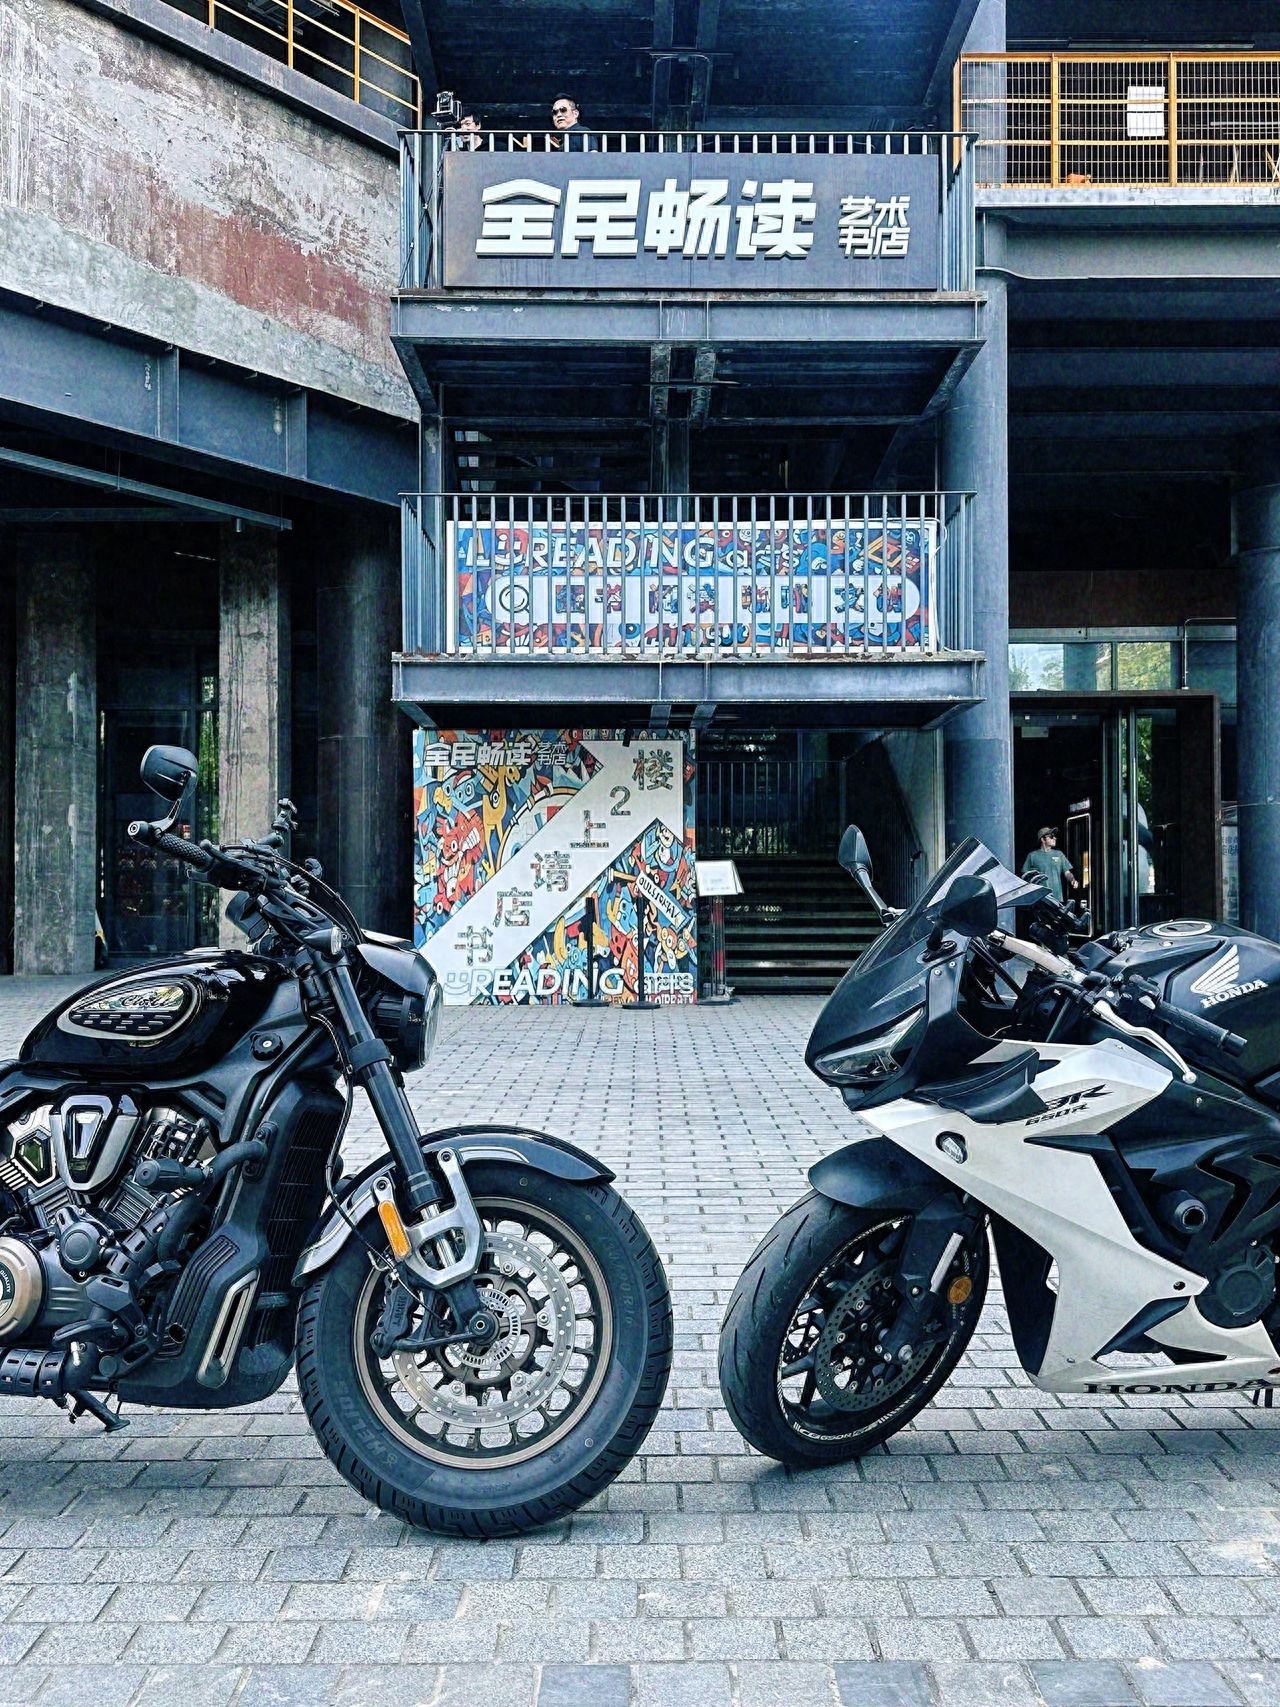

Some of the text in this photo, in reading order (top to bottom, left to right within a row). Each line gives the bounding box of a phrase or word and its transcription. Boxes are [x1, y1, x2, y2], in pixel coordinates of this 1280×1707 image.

[475, 178, 817, 259] 全民畅读
[838, 195, 910, 227] 艺术
[838, 225, 910, 259] 书店
[525, 537, 715, 568] READING
[424, 741, 533, 767] 全民畅读
[537, 741, 567, 754] 艺术
[537, 753, 567, 766] 书店
[470, 968, 625, 996] READING
[1200, 979, 1269, 1009] HONDA
[1083, 1378, 1277, 1395] HONDA
